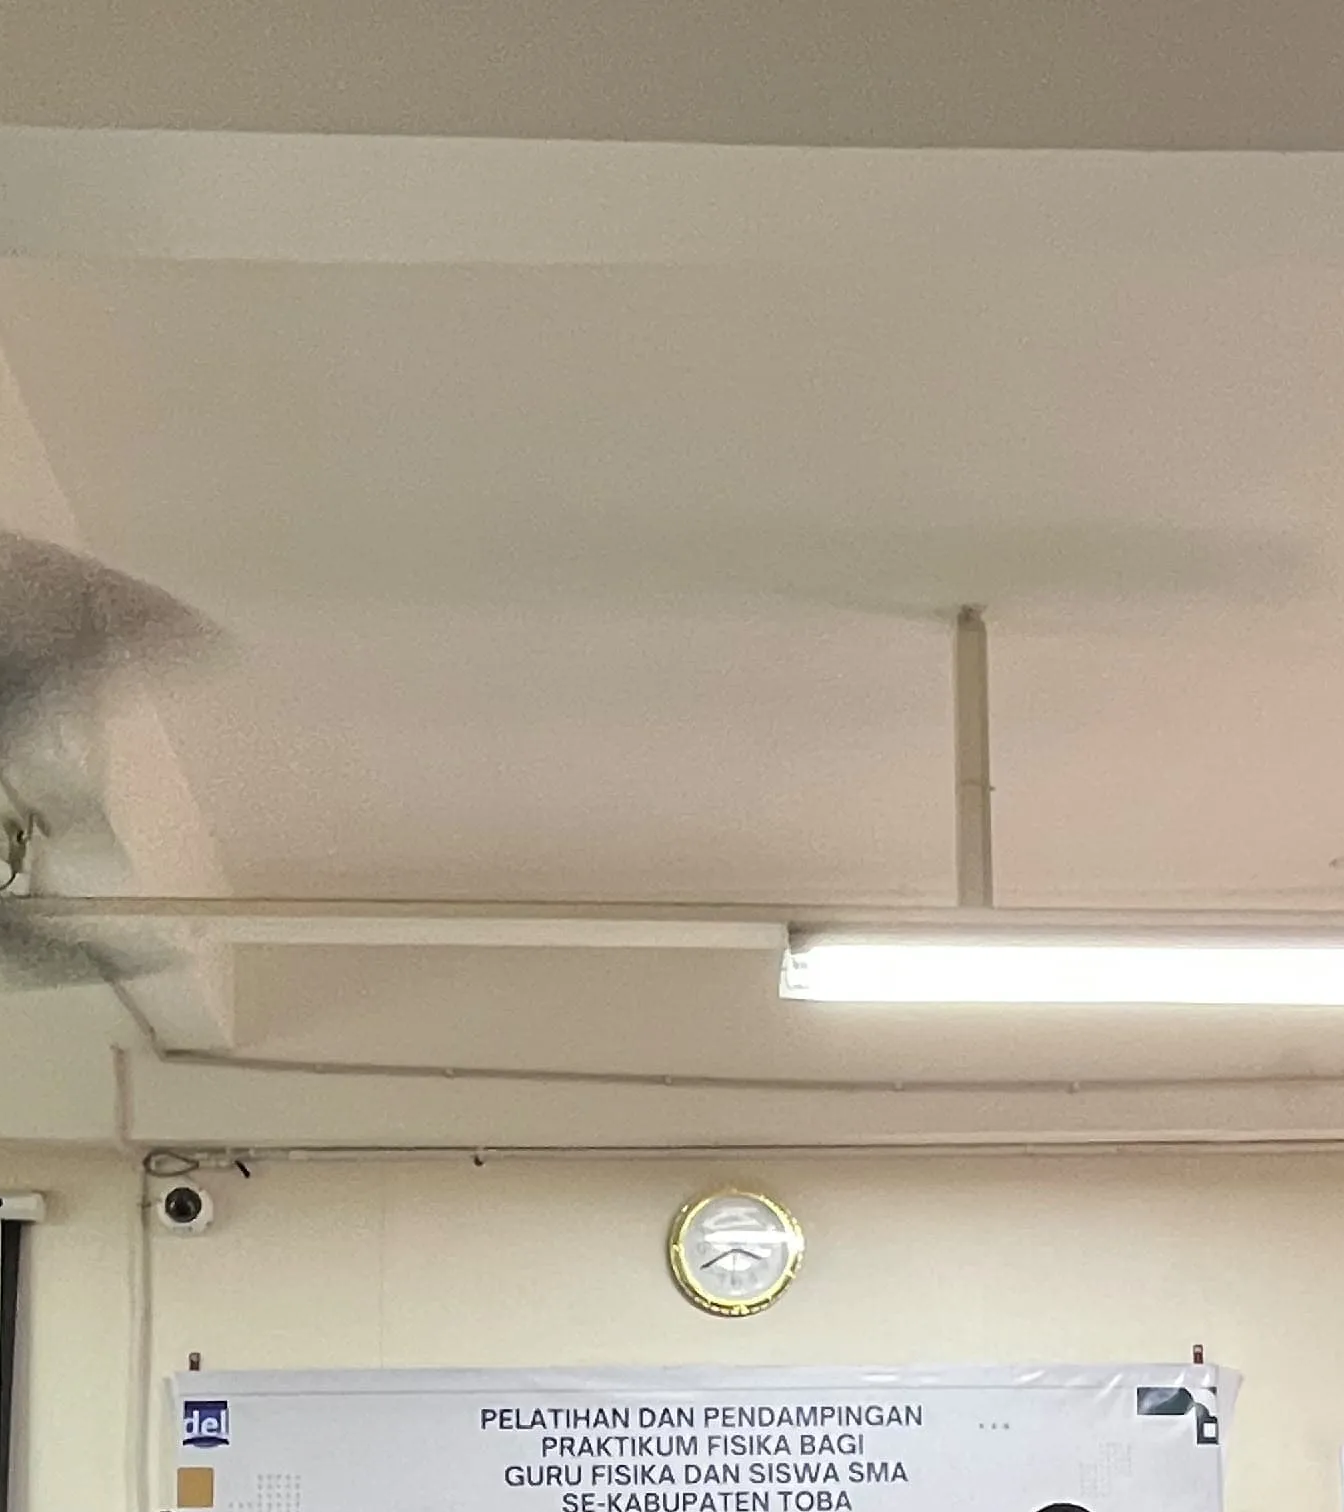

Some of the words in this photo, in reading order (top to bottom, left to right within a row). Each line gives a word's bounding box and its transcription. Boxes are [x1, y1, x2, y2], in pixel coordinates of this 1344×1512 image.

[184, 1409, 226, 1436] del
[480, 1407, 630, 1430] PELATIHAN
[638, 1406, 694, 1428] DAN
[703, 1405, 923, 1428] PENDAMPINGAN
[541, 1435, 698, 1457] PRAKTIKUM
[707, 1434, 792, 1456] FISIKA
[800, 1434, 864, 1455] BAGI
[505, 1465, 582, 1486] GURU
[591, 1464, 676, 1485] FISIKA
[684, 1463, 740, 1484] DAN
[748, 1462, 840, 1484] SISWA
[848, 1461, 909, 1483] SMA
[777, 1490, 853, 1512] TOBA
